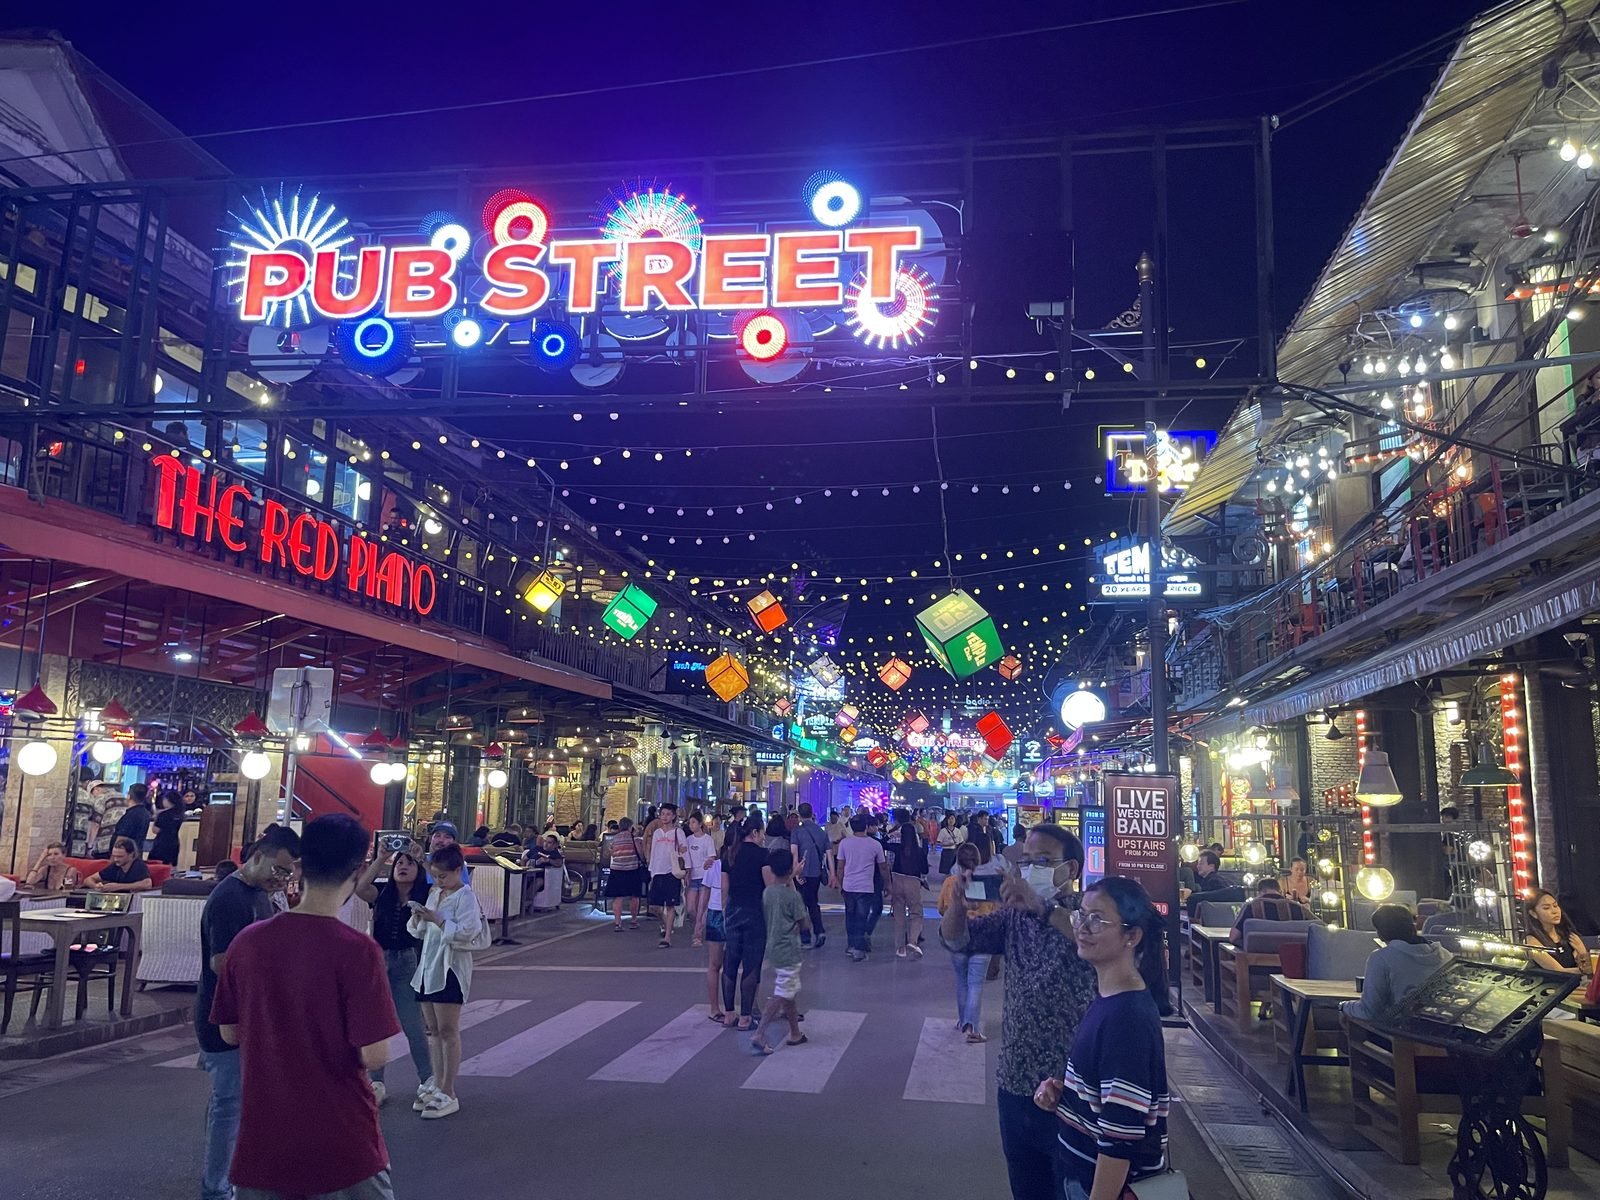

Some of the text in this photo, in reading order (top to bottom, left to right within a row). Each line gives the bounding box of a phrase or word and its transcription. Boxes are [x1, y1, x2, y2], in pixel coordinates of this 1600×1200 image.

[240, 226, 923, 321] PUB STREET
[153, 454, 437, 616] THE RED PIANO
[1104, 585, 1118, 594] 20
[1167, 585, 1199, 593] RIENCE
[1494, 611, 1529, 643] PIZZA
[1546, 587, 1580, 620] TOWN
[965, 631, 988, 667] TEMPLE
[1116, 789, 1165, 809] LIVE
[1117, 808, 1165, 819] WESTERN
[1088, 825, 1104, 834] DRAF
[1117, 818, 1165, 836] BAND
[1117, 839, 1166, 851] UPSTAIRS
